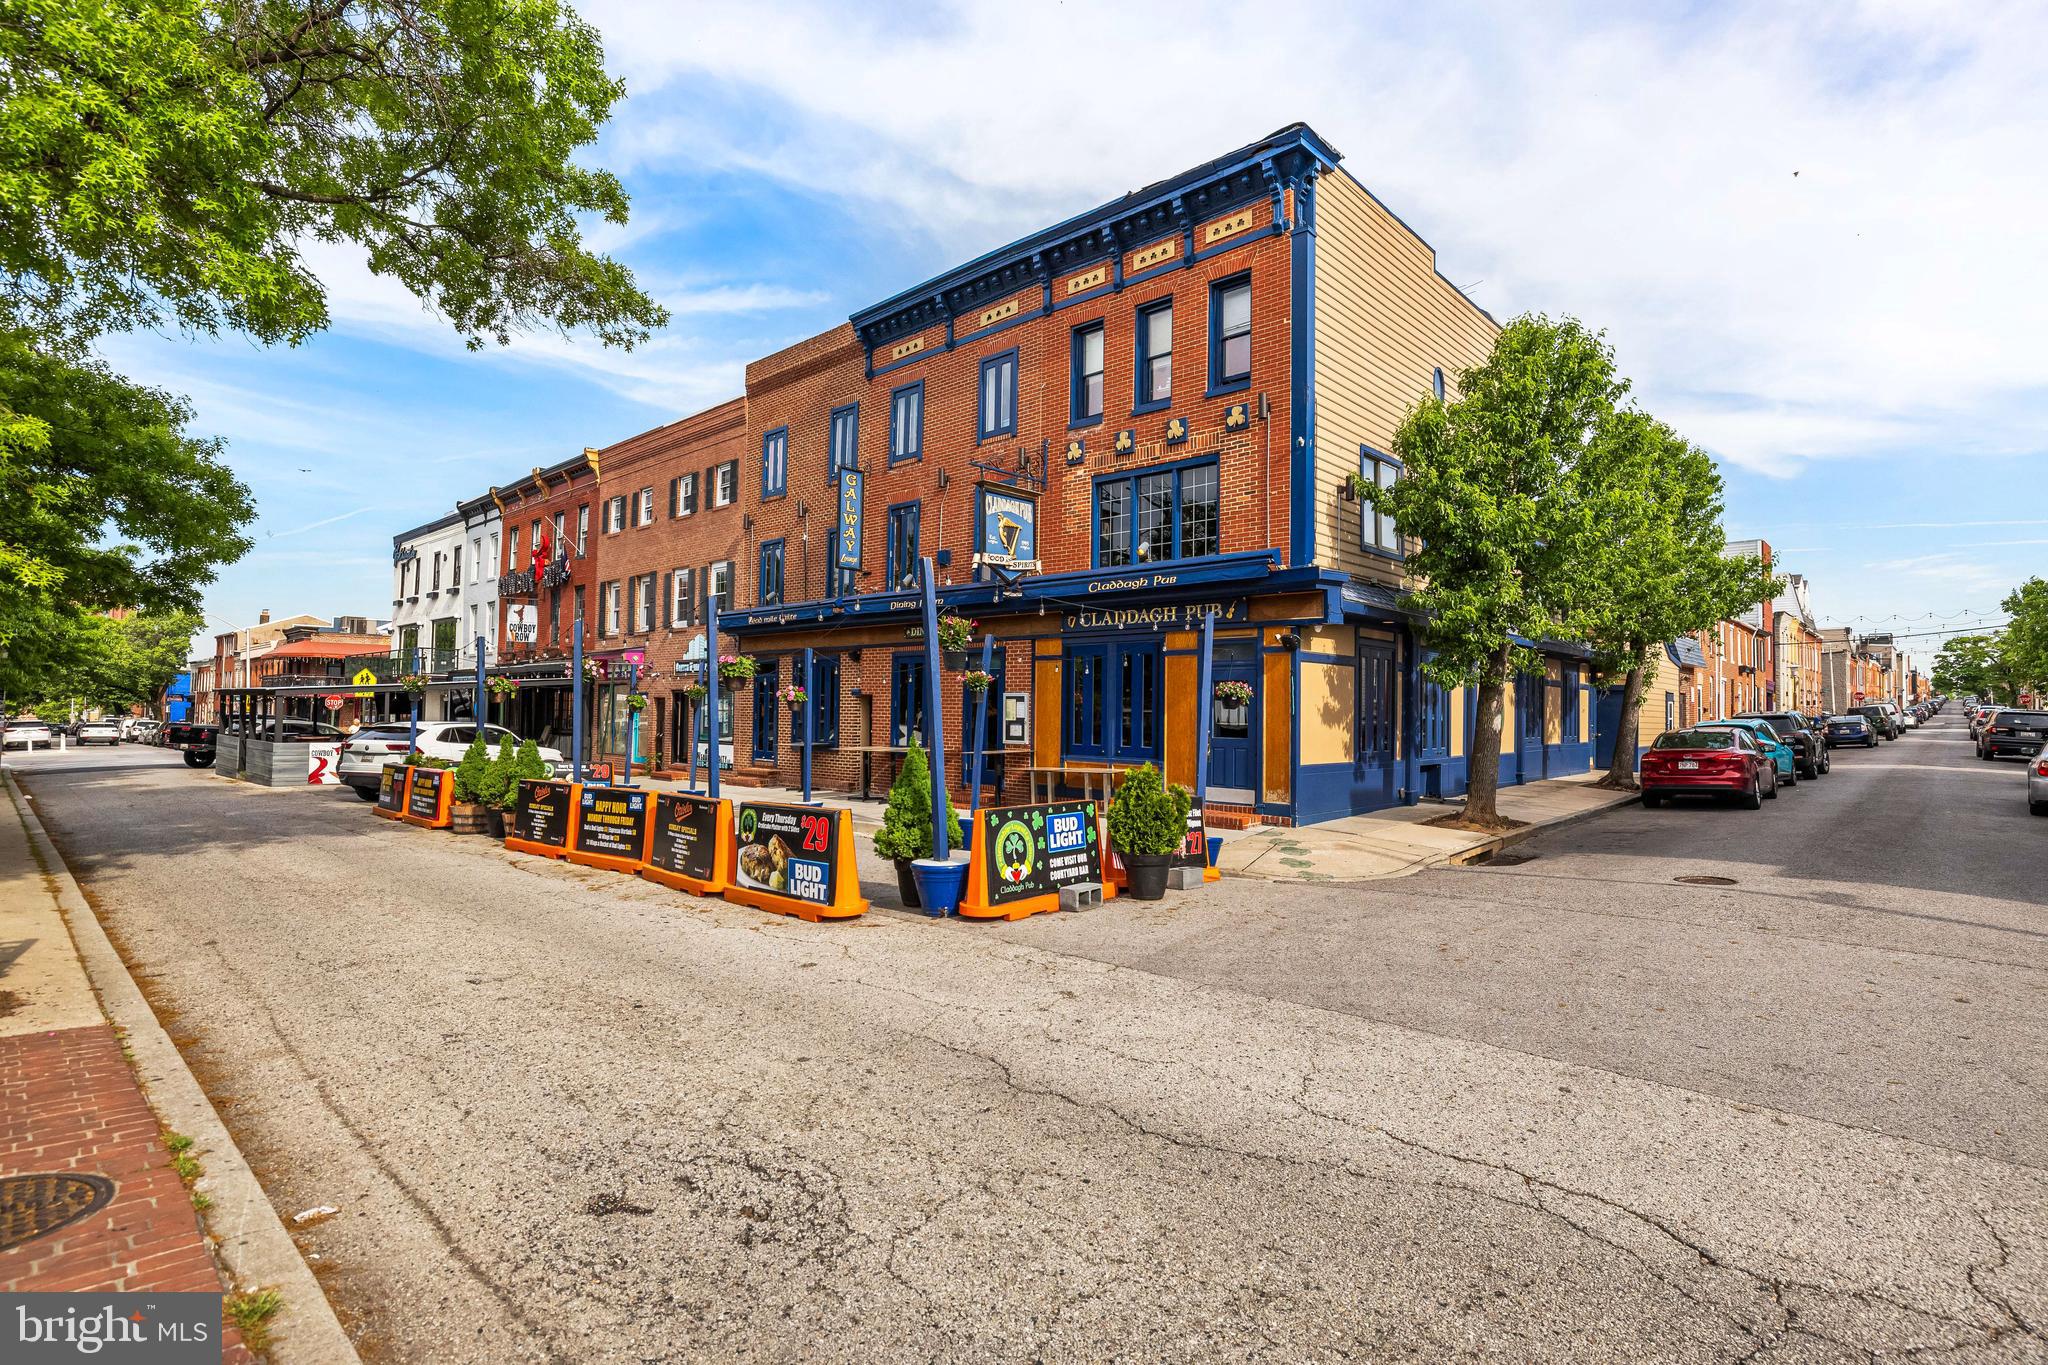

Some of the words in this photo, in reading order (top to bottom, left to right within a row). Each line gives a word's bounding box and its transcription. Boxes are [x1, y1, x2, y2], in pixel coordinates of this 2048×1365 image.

[843, 474, 858, 551] GALWAY
[1088, 577, 1148, 593] Claddagh
[890, 601, 917, 610] Dining
[1081, 605, 1178, 627] CLADDAGH
[1184, 603, 1223, 622] PUB
[509, 623, 537, 634] COWBOY
[515, 632, 530, 642] ROW
[311, 749, 334, 757] COWBOY
[595, 800, 612, 813] HAPPY
[611, 802, 627, 814] HOUR
[620, 817, 635, 827] FRIDAY
[762, 812, 775, 824] Every
[774, 813, 797, 826] Thursday
[1053, 816, 1078, 833] BUD
[800, 814, 829, 853] $29
[1049, 830, 1084, 848] LIGHT
[1186, 831, 1203, 855] $27
[1049, 856, 1064, 868] COME
[1064, 854, 1077, 866] VISIT
[1077, 852, 1088, 864] OUR
[794, 863, 822, 883] BUD
[1050, 866, 1079, 881] COURTYARD
[1078, 864, 1089, 876] BAR
[790, 878, 827, 900] LIGHT
[1024, 881, 1035, 890] Pub
